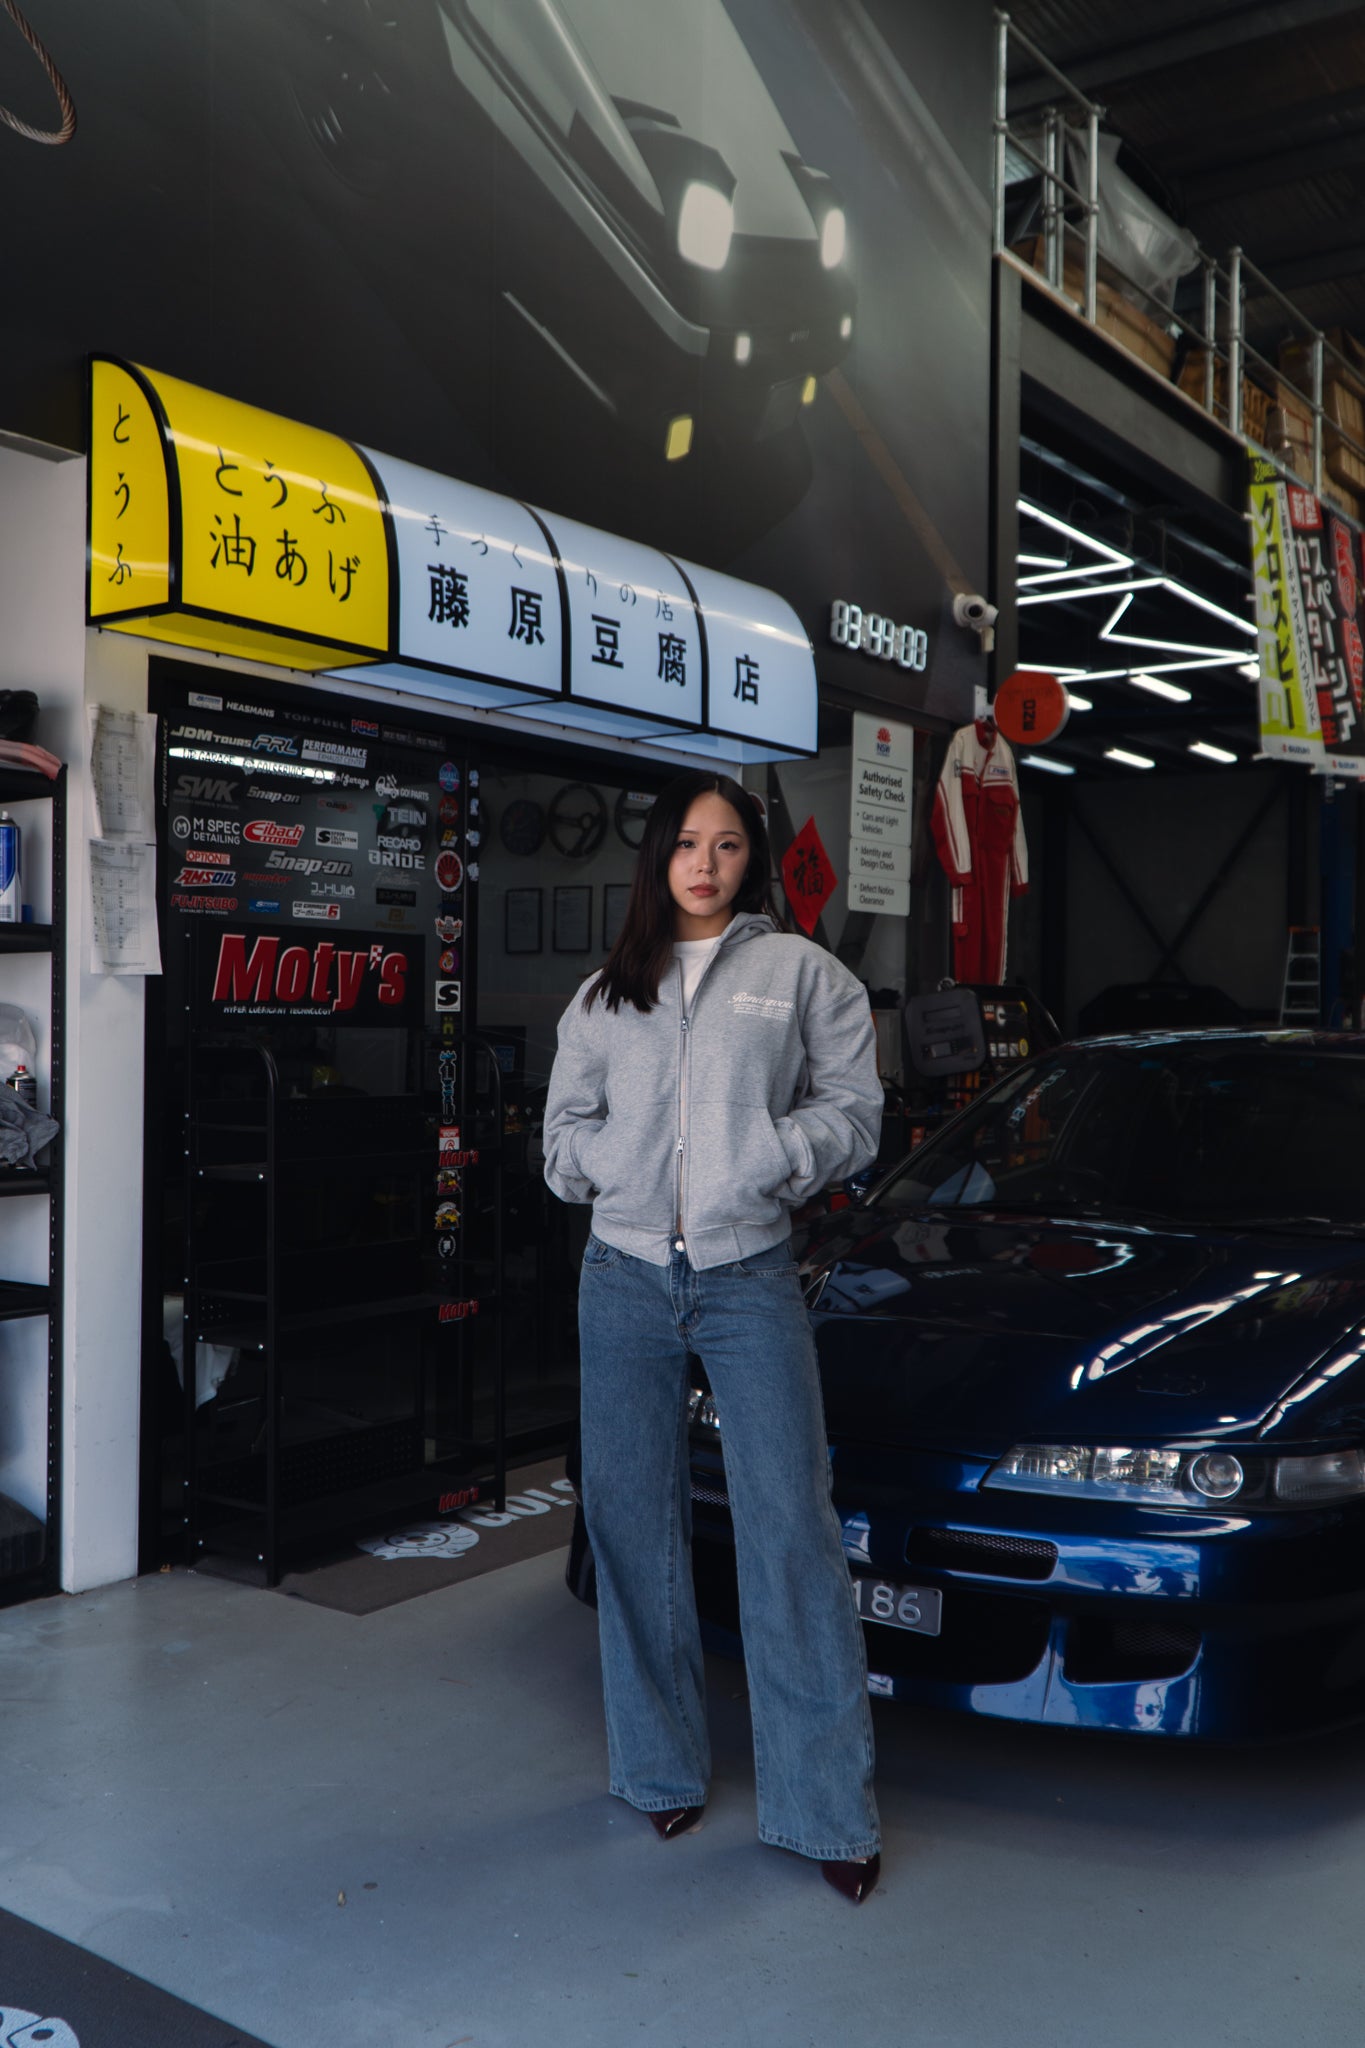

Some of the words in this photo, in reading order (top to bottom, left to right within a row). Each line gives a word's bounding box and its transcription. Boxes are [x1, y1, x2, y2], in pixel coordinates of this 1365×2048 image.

[108, 403, 132, 585] とうふ
[215, 446, 346, 524] とうふ
[209, 513, 361, 602] 油あげ
[426, 563, 760, 706] 藤原豆腐店
[226, 700, 276, 719] HEASMANS
[170, 725, 213, 742] JDM
[212, 733, 252, 748] TOURS
[303, 739, 368, 759] PERFORMANCE
[876, 742, 891, 754] NSW
[317, 752, 343, 765] EXHAUST
[173, 774, 239, 803] SWK
[863, 770, 903, 788] Authorised
[246, 785, 301, 805] Snap-on
[859, 783, 882, 801] Safety
[884, 790, 905, 803] Check
[387, 806, 427, 826] TEIN
[862, 811, 873, 822] Cars
[873, 814, 885, 824] and
[885, 815, 899, 828] Light
[193, 817, 205, 831] M
[206, 818, 241, 835] SPEC
[245, 820, 305, 842] Eibach
[862, 823, 883, 836] Vehicles
[193, 831, 241, 846] DETAILING
[377, 834, 421, 851] RECARO
[187, 850, 222, 864] OPTION
[368, 849, 426, 870] BRIDE
[861, 846, 882, 859] Identity
[883, 849, 893, 858] and
[265, 849, 352, 877] Snap-on
[860, 858, 879, 870] Design
[879, 860, 895, 871] Check
[175, 868, 236, 886] AMSOIL
[860, 883, 877, 893] Defect
[878, 885, 895, 896] Notice
[171, 894, 239, 911] FUJITSUBO
[859, 895, 885, 906] Clearance
[212, 933, 409, 1013] Moty's
[223, 1005, 247, 1014] HYPER
[248, 1006, 286, 1015] LUBRICANT
[289, 1007, 331, 1016] TECHNOLOGY
[439, 1149, 480, 1168] Moty's
[438, 1299, 479, 1321] Moty's
[438, 1486, 480, 1512] Moty's
